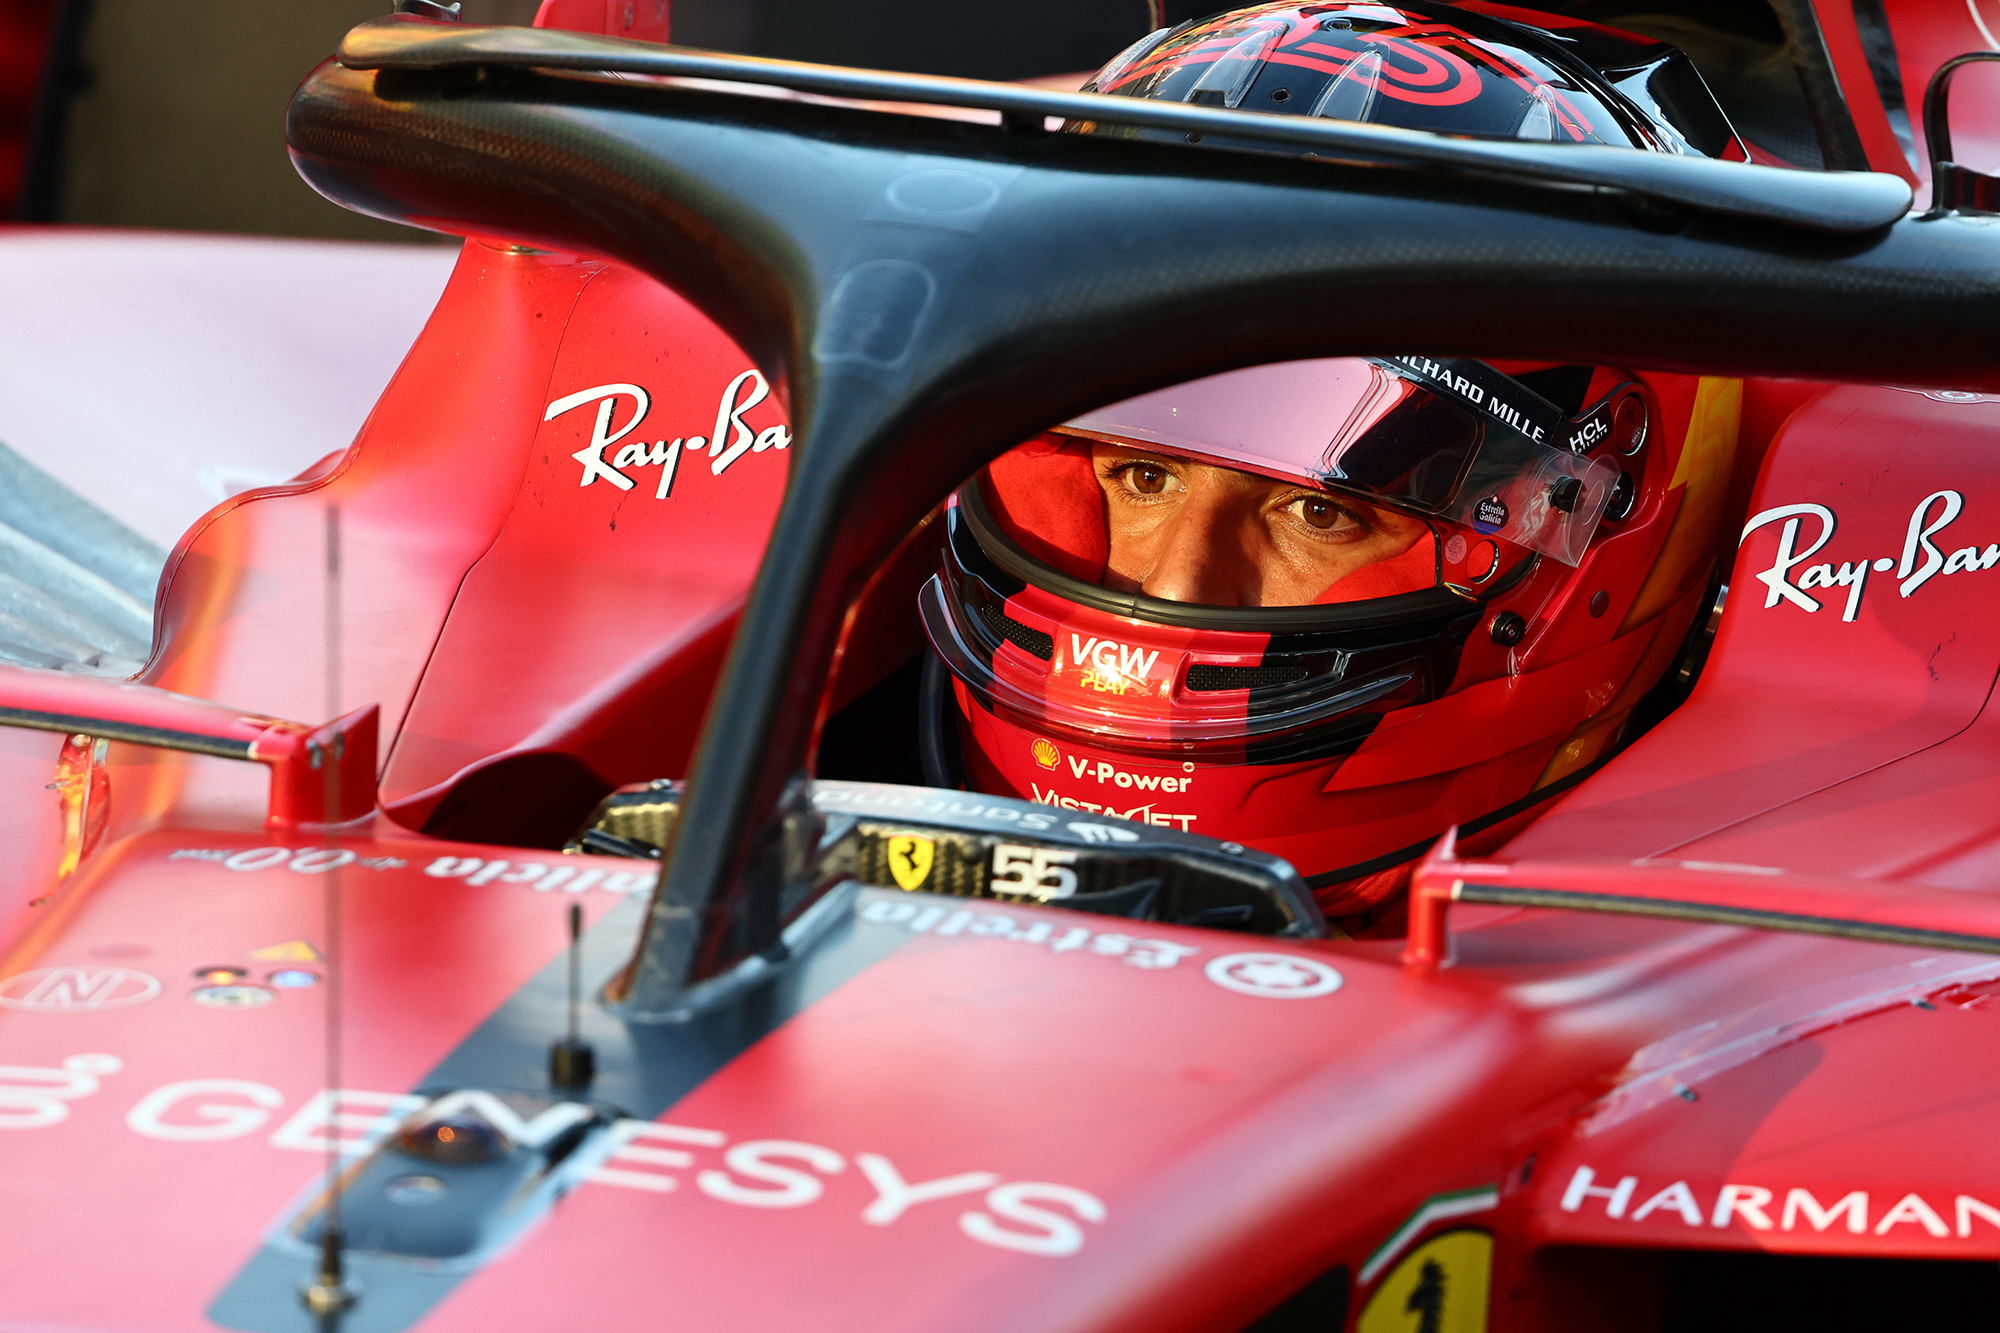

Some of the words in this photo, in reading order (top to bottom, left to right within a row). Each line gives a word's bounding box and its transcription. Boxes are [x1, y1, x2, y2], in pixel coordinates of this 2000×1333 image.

[1394, 355, 1485, 405] ICHARD
[1488, 397, 1545, 445] MILLE
[543, 368, 793, 500] Ray-Ba
[1568, 417, 1608, 452] HCL
[1479, 511, 1502, 525] Galicia
[1480, 501, 1505, 516] Estrella
[1071, 633, 1160, 679] VGW
[1080, 669, 1132, 695] PLAY
[1067, 755, 1192, 793] V-Power
[425, 856, 658, 894] alicia
[990, 843, 1078, 900] 55
[862, 903, 1200, 970] Estrella
[125, 1077, 1107, 1257] GENESYS
[1560, 1164, 2000, 1238] HARMAN
